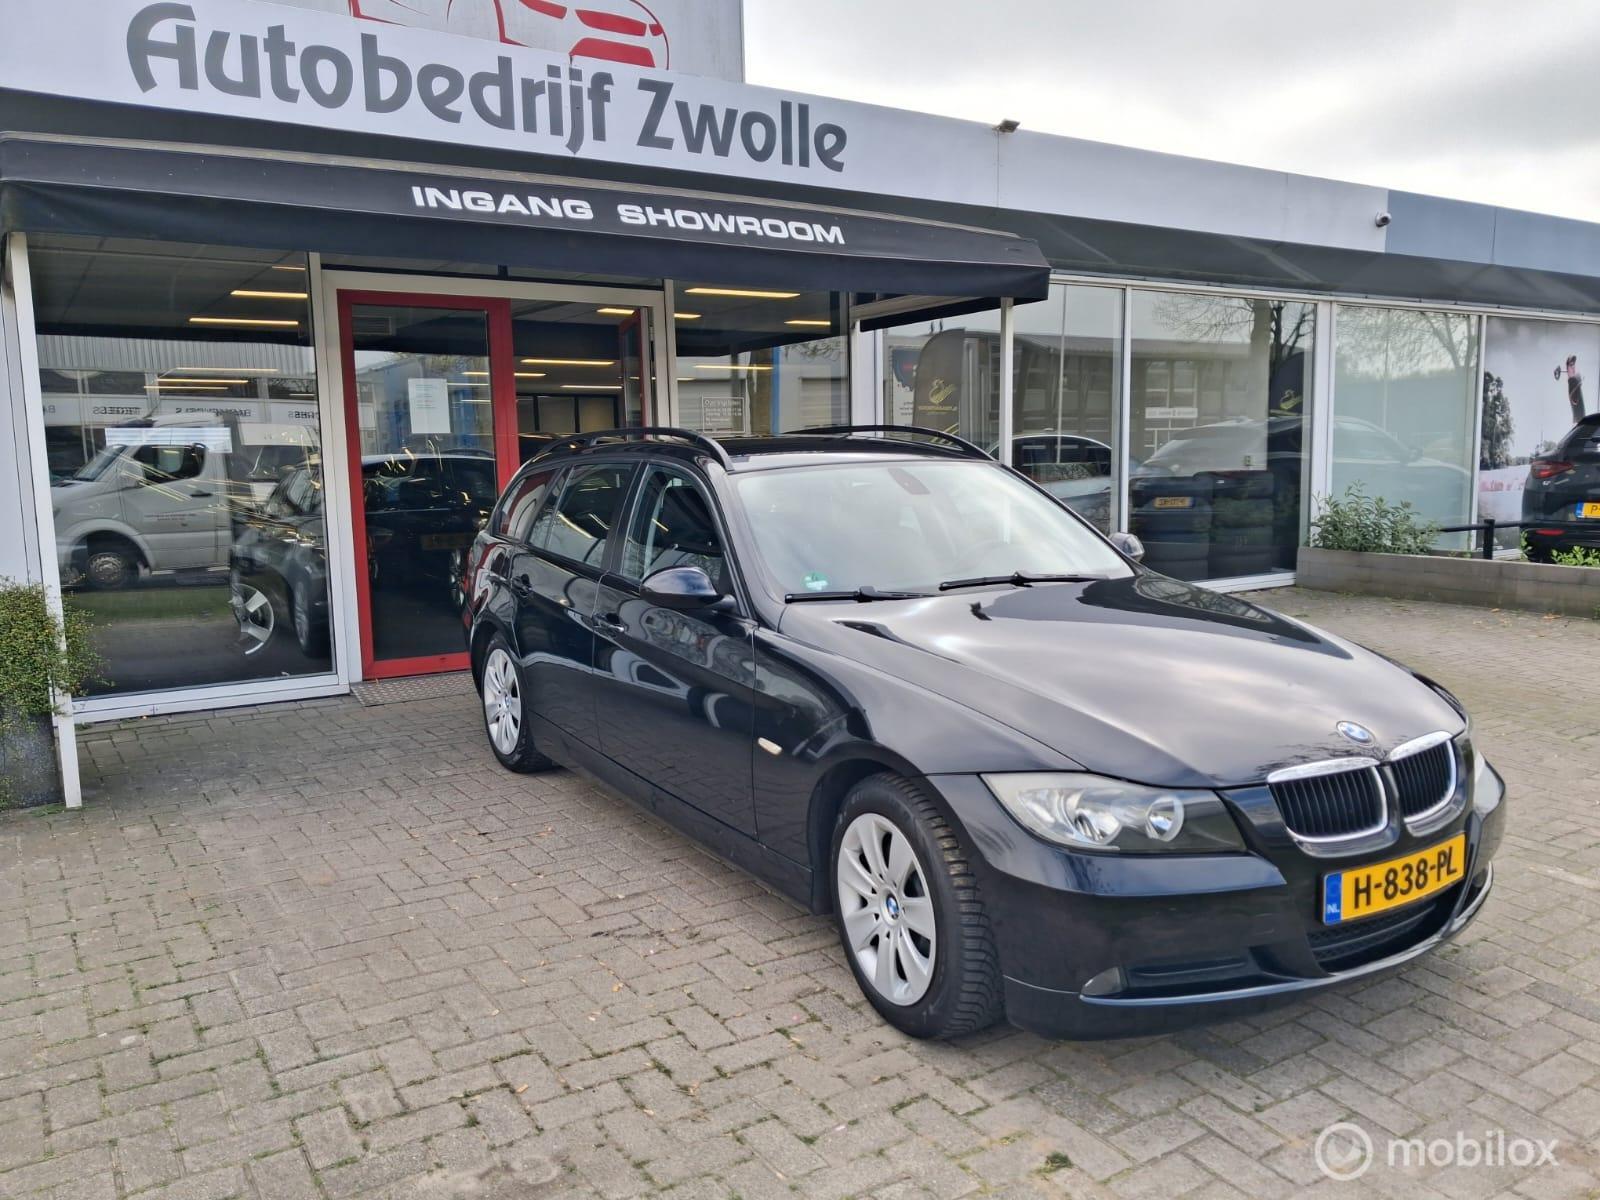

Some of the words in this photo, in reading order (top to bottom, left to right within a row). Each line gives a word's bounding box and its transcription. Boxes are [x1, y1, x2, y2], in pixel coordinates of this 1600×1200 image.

[126, 2, 614, 155] Autobedrijf
[636, 77, 848, 173] Zwolle
[411, 185, 594, 220] INGANG
[616, 203, 846, 245] SHOWROOM
[1353, 846, 1458, 909] H-838-PL
[1326, 903, 1340, 914] NL
